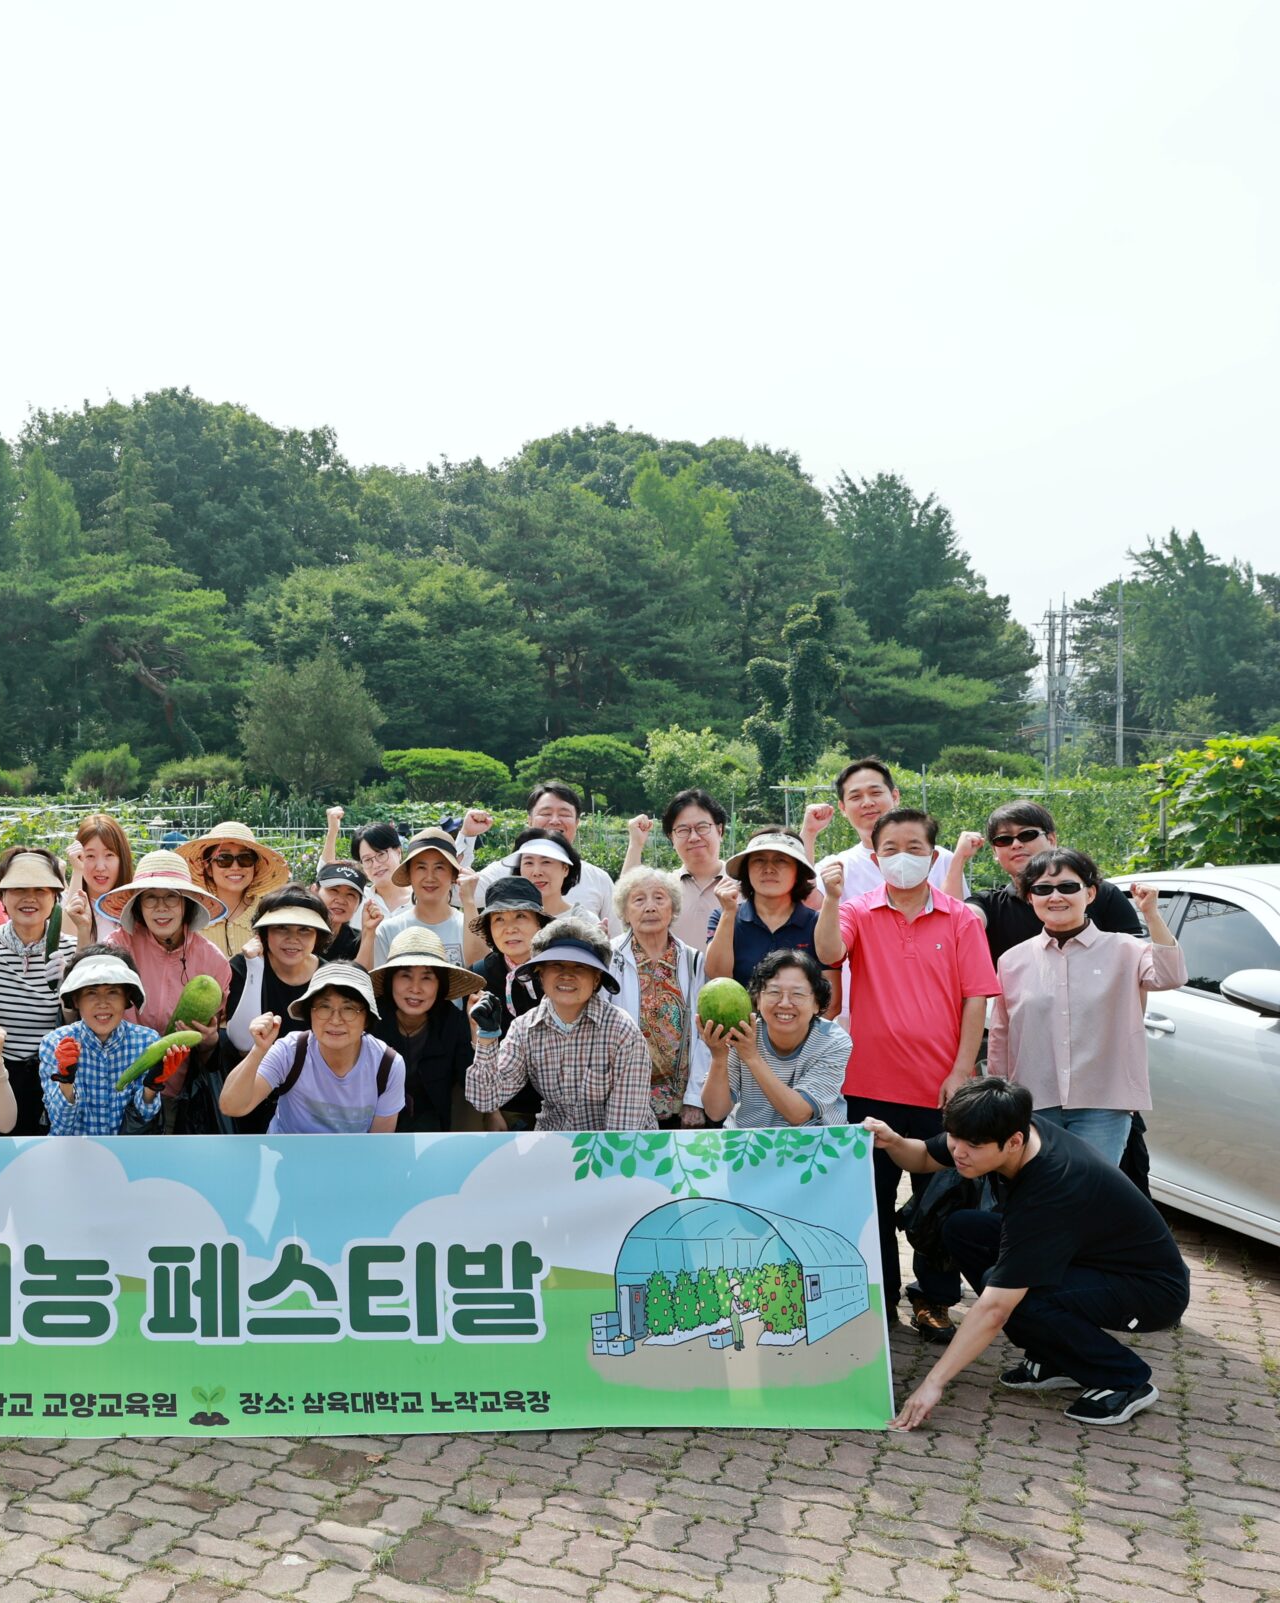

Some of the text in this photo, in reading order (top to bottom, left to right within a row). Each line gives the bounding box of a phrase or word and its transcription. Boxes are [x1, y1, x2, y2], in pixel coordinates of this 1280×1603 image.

[148, 1240, 543, 1338] 페스티발
[42, 1392, 178, 1418] 교양교육원
[239, 1390, 551, 1415] 장소: 삼육대학교 노작교육장
